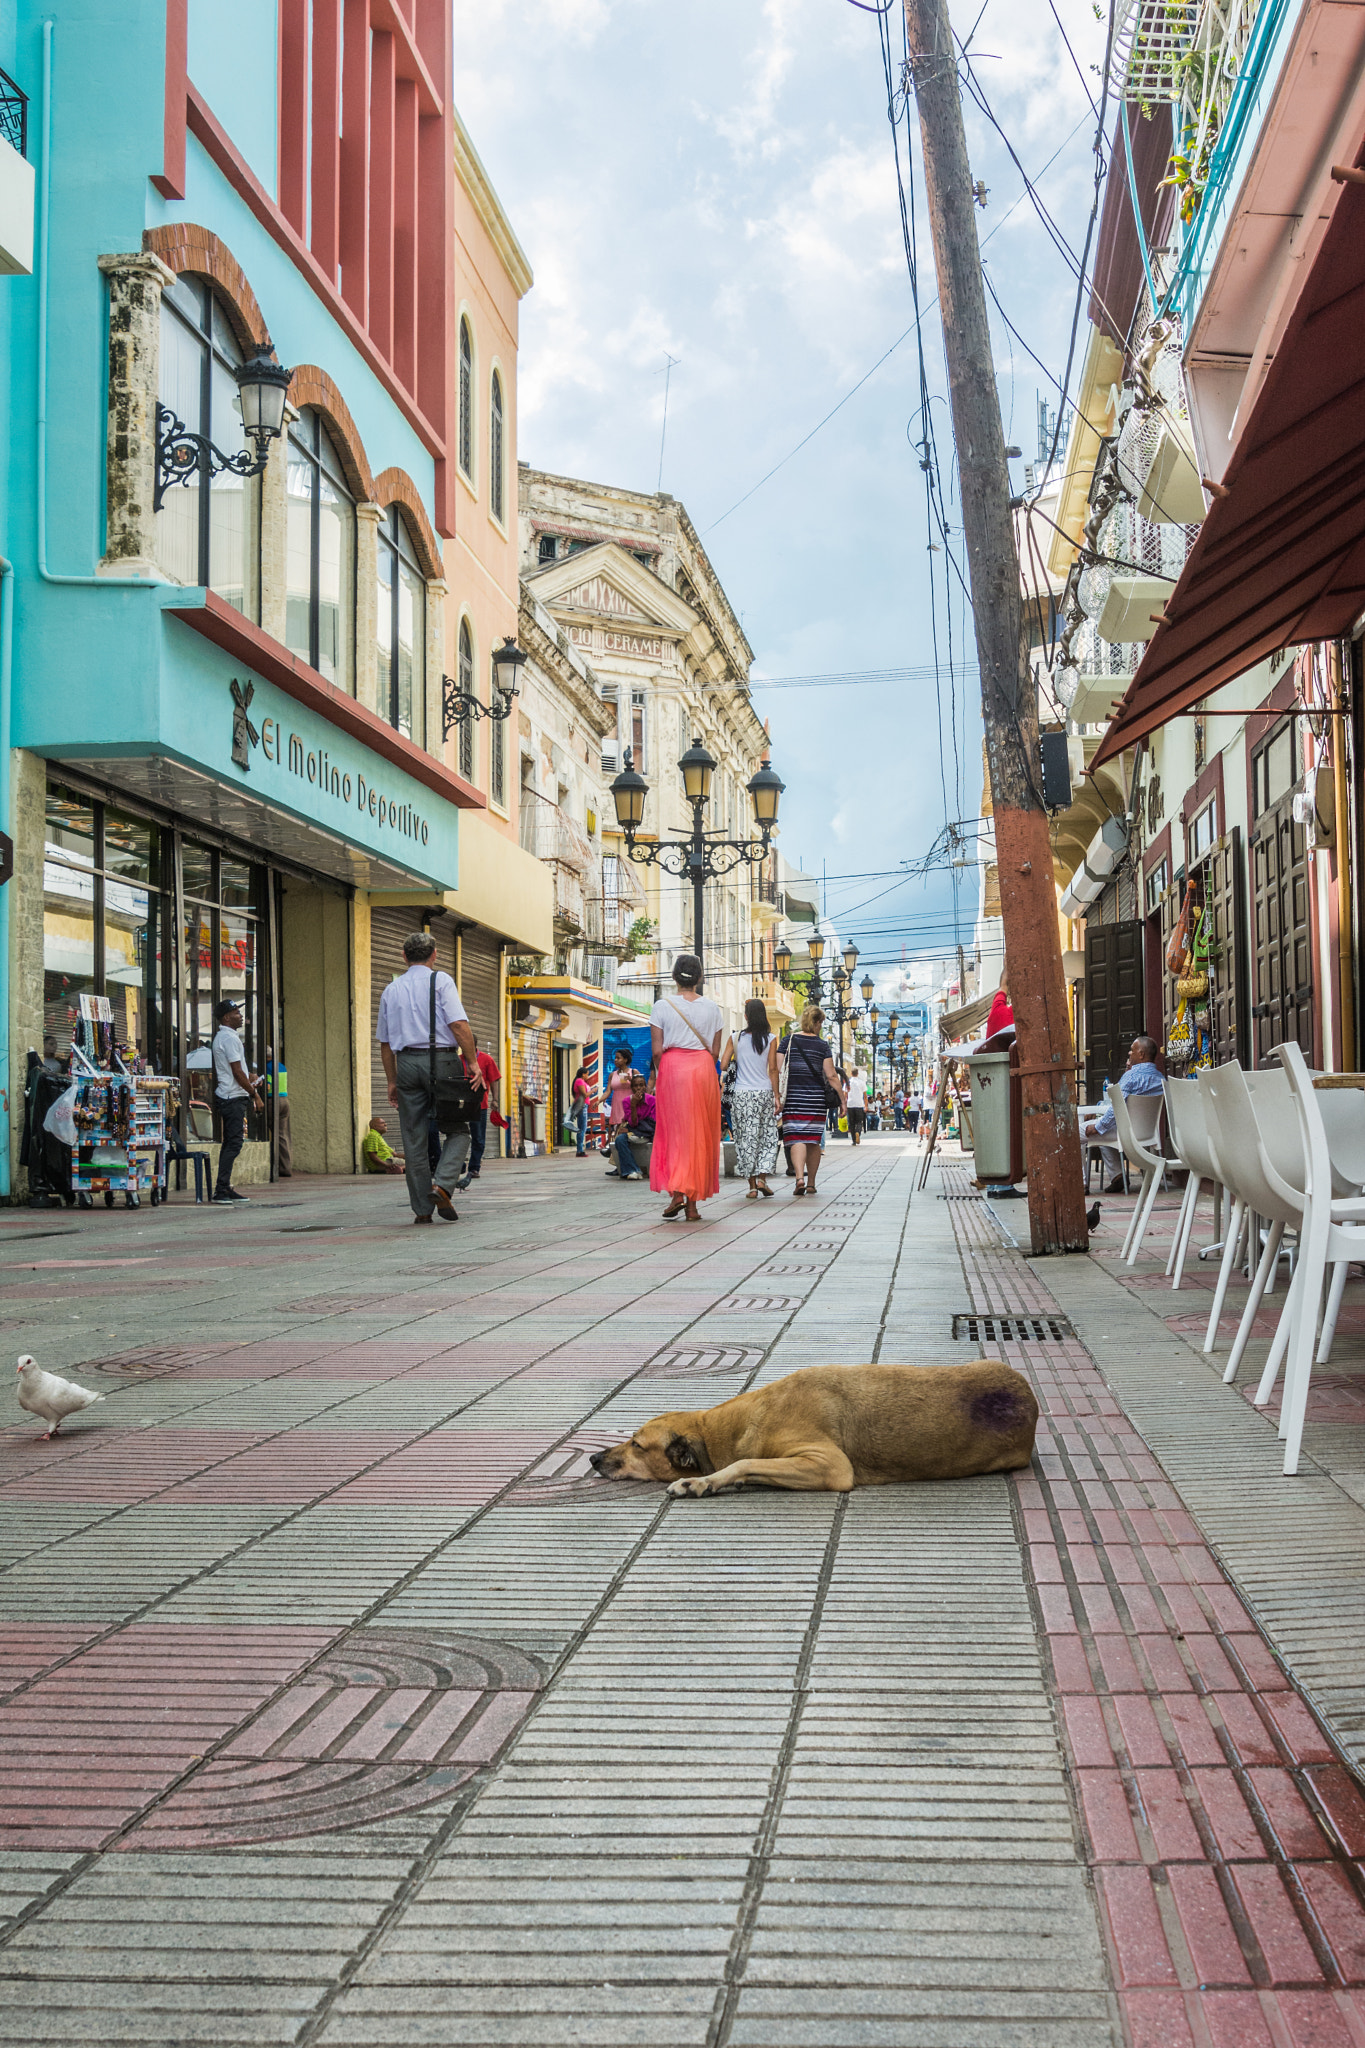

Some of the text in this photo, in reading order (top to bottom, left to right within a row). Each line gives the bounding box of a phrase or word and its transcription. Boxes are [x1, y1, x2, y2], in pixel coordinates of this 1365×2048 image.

[605, 632, 661, 656] CERAME
[262, 718, 428, 846] El Molino Deportivo
